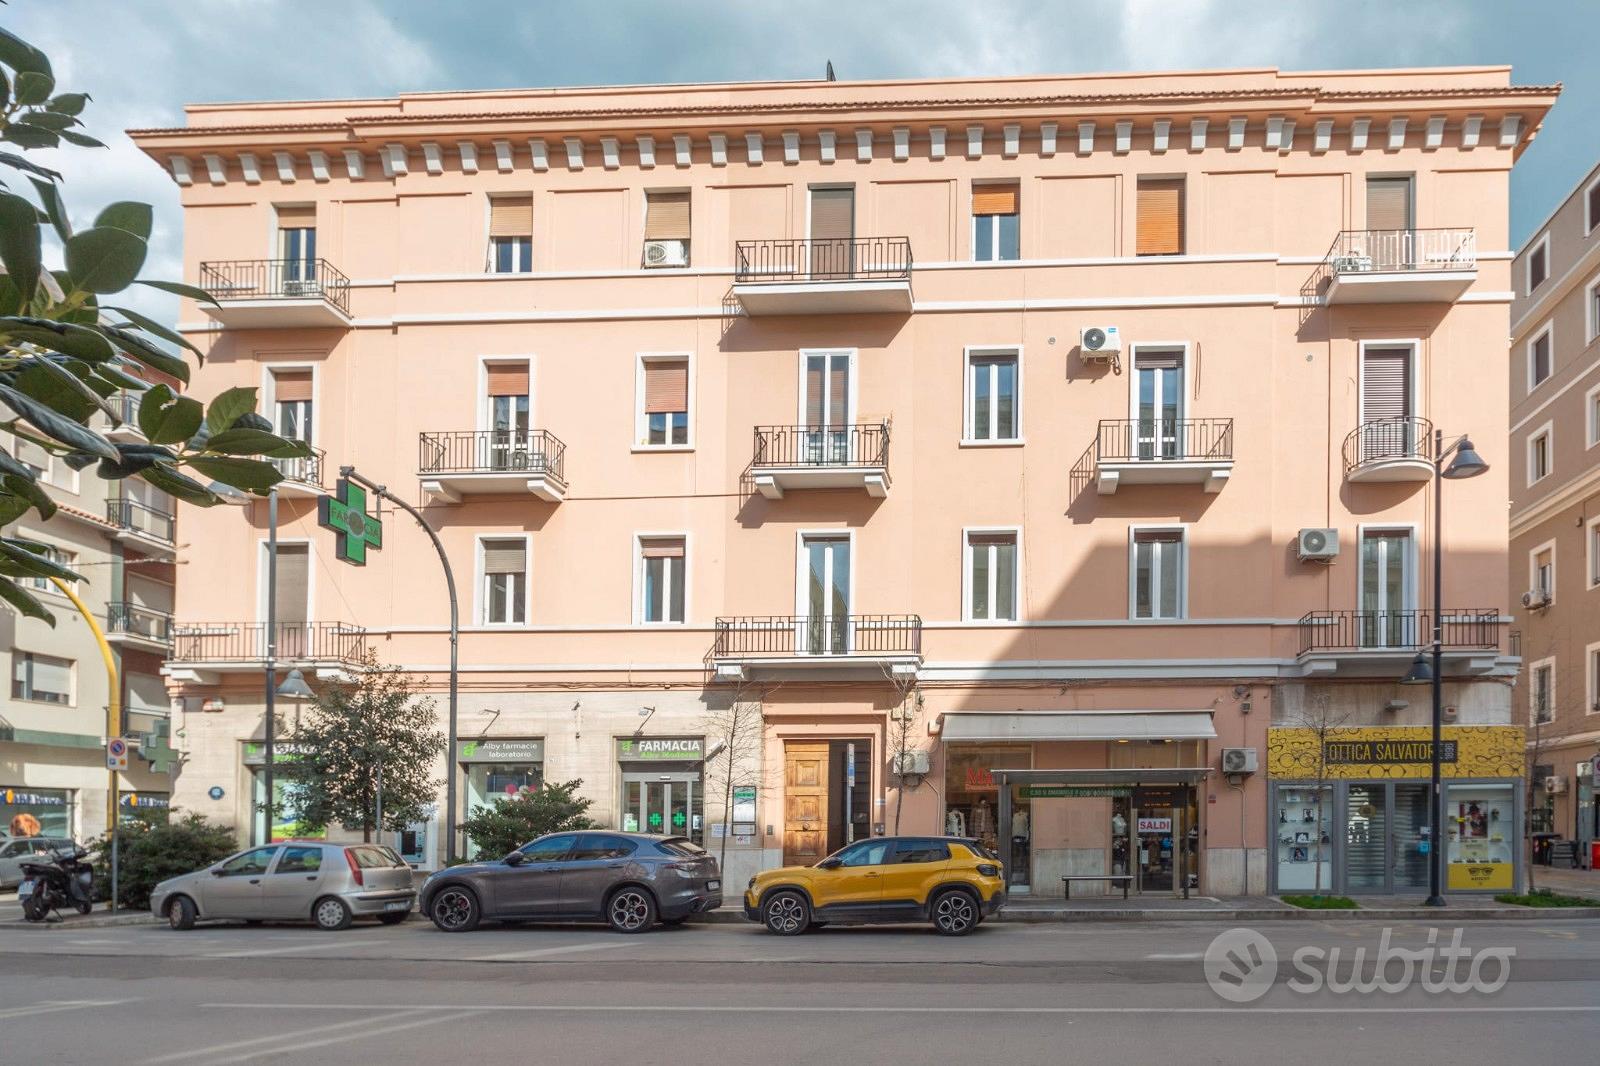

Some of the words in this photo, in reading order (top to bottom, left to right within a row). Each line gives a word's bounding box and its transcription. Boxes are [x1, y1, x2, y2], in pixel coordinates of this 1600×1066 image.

[483, 743, 500, 751] Alby
[502, 742, 537, 750] farmacie
[639, 740, 700, 751] FARMACIA
[1329, 744, 1371, 760] OTTICA
[1140, 821, 1169, 830] SALDI
